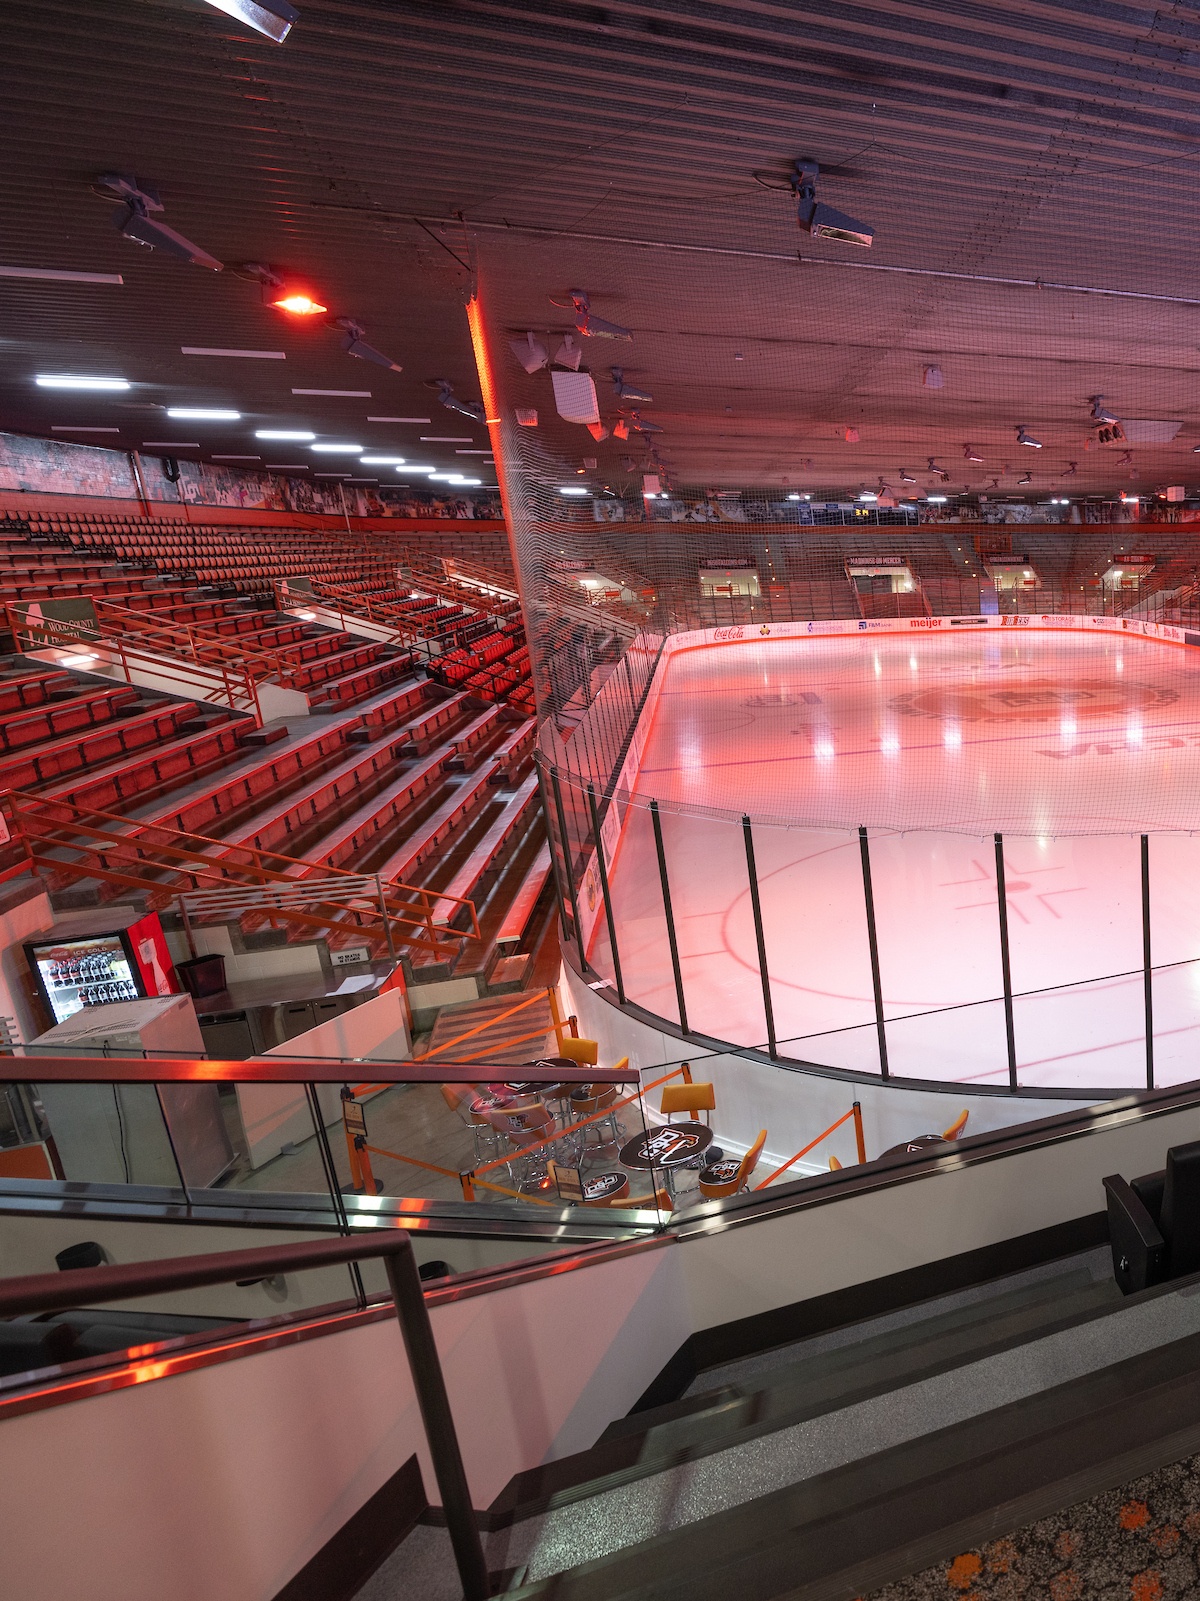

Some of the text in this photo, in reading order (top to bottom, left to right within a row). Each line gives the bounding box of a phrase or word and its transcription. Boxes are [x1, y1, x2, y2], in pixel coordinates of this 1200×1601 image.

[48, 619, 94, 632] WOOD COUNTY
[910, 617, 942, 628] meijer
[1120, 1256, 1128, 1270] A
